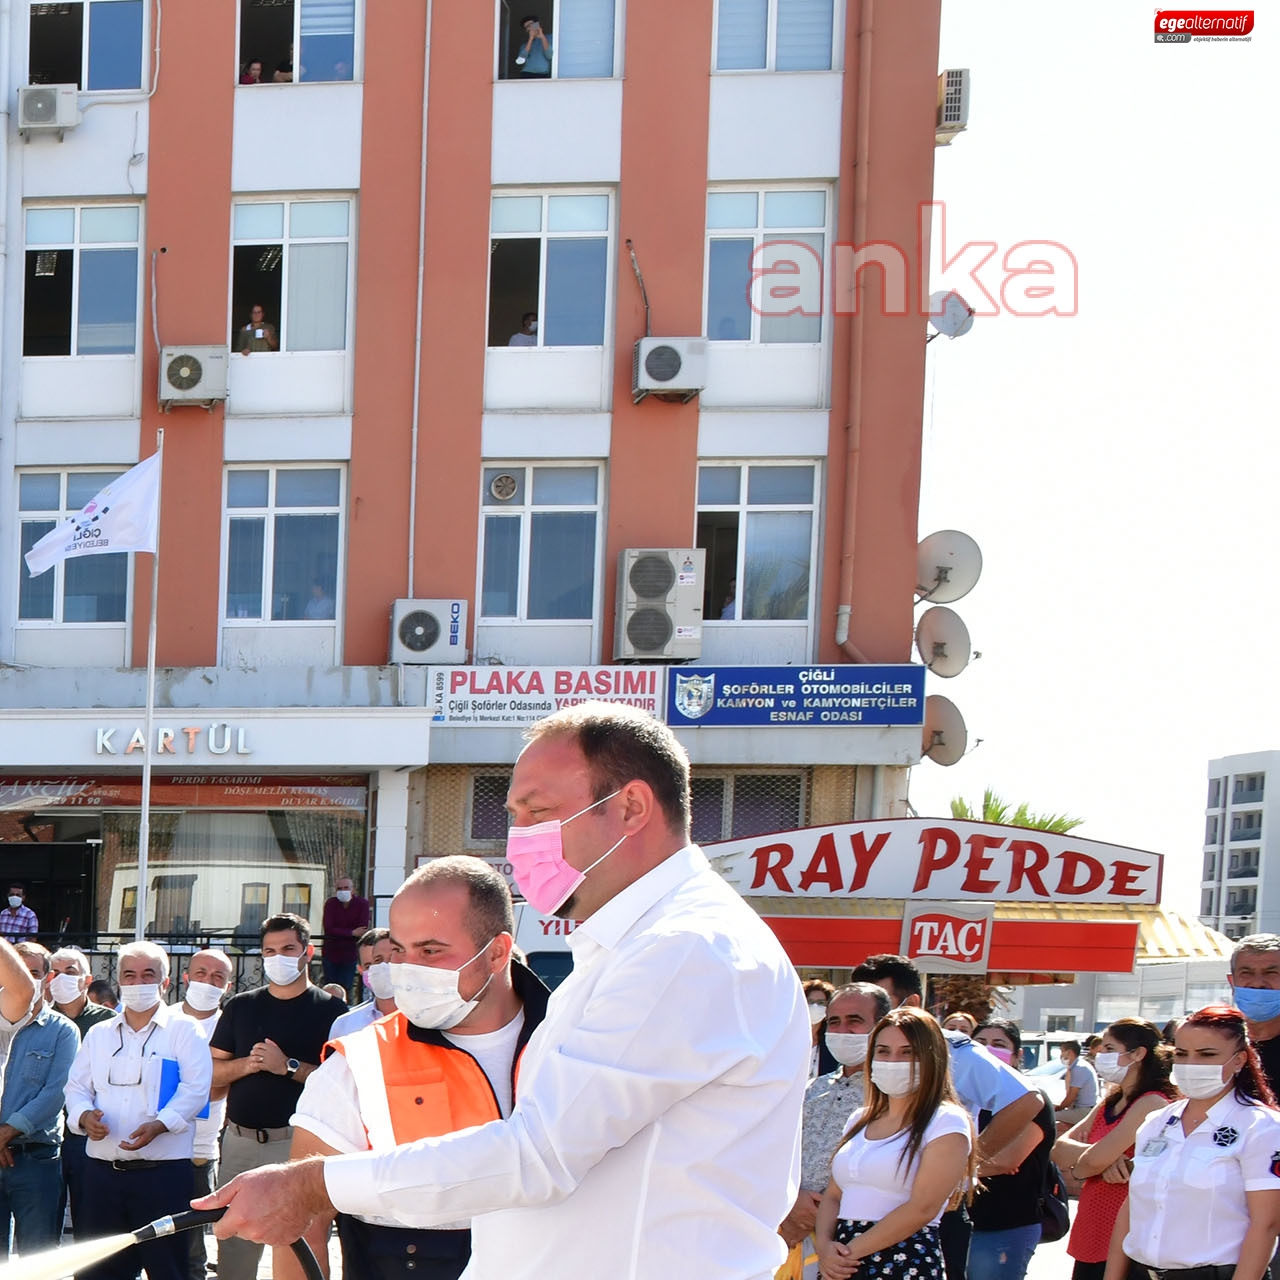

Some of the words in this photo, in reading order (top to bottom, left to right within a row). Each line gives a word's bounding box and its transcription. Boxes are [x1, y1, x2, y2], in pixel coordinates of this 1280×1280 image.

[449, 602, 461, 646] BEKO
[450, 670, 546, 695] PLAKA
[554, 670, 657, 695] BASIMI
[798, 668, 836, 683] ÇİĞLİ
[722, 682, 795, 697] ŞOFÖRLER
[801, 681, 913, 695] OTOMOBİLCİLER
[449, 700, 469, 714] Çiğli
[471, 700, 507, 714] Şoförler
[509, 700, 552, 711] Odasında
[717, 697, 775, 708] KAMYON
[781, 699, 797, 708] ve
[803, 695, 917, 711] KAMYONETÇİLER
[770, 711, 814, 721] ESNAF
[820, 711, 863, 721] ODASI
[95, 722, 254, 756] KARTÜL
[171, 776, 208, 784] PERDE
[209, 776, 263, 785] TASARIMI
[749, 830, 893, 894] RAY
[912, 827, 1153, 898] PERDE
[914, 920, 984, 959] TAÇ
